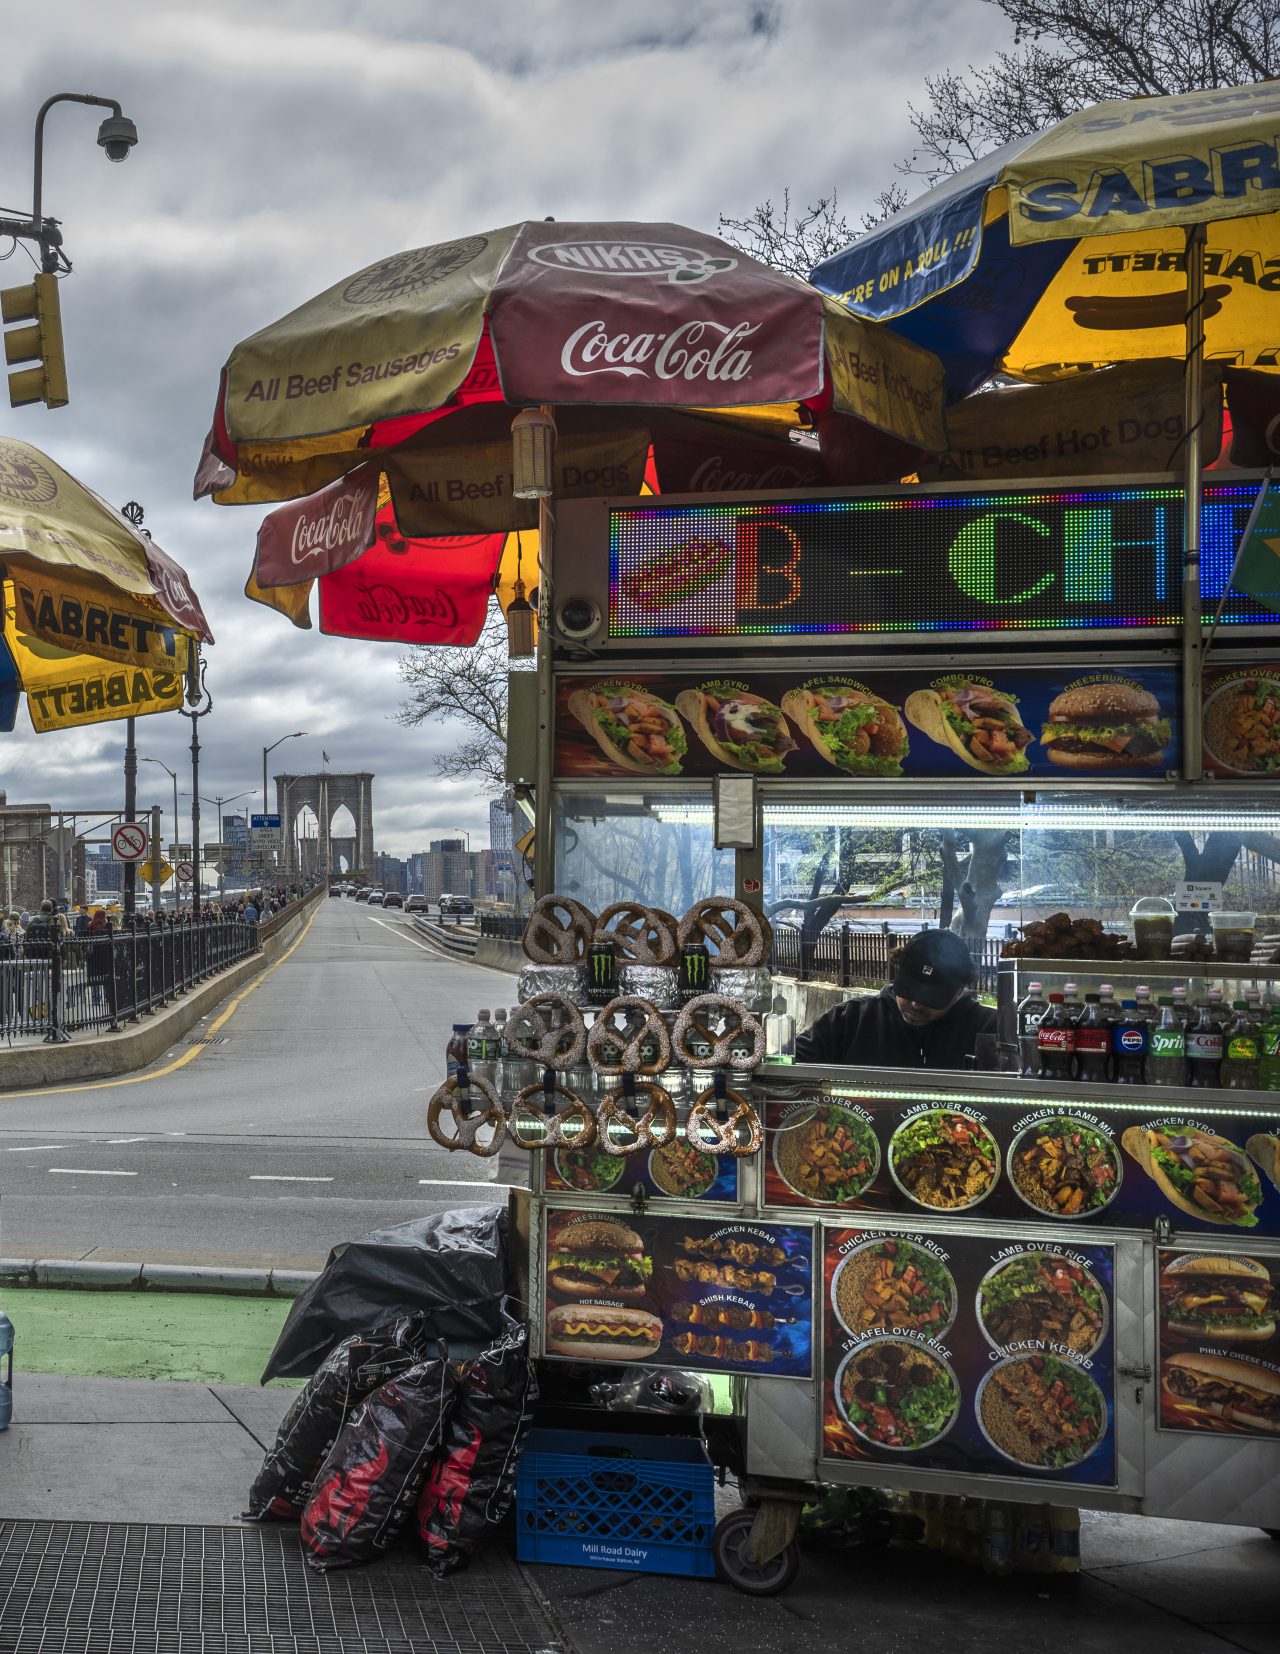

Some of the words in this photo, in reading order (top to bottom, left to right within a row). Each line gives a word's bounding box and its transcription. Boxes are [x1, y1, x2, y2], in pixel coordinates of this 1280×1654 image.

[1018, 137, 1280, 222] SABR
[554, 243, 686, 271] NIKAS
[879, 266, 900, 293] ON
[904, 260, 914, 281] A
[917, 238, 949, 271] ROLL
[561, 320, 763, 381] Coca-Cola
[244, 379, 280, 403] All
[285, 366, 344, 399] Beef
[348, 342, 461, 390] Sausages
[849, 352, 880, 385] Beef
[939, 451, 974, 476] All
[981, 437, 1054, 468] Beef
[1057, 425, 1112, 456] Hot
[410, 483, 439, 503] All
[446, 476, 504, 500] Beef
[562, 462, 629, 490] Dogs
[291, 486, 368, 565] Coca-Cola
[17, 581, 178, 657] SABRETT
[624, 680, 649, 696] GYRO
[695, 679, 720, 694] LAMB
[723, 679, 750, 692] GYRO
[827, 674, 876, 699] SANDWICH
[930, 673, 965, 689] COMBO
[967, 673, 994, 688] GYRO
[1063, 673, 1144, 694] CHEESEBURGER
[1204, 669, 1248, 696] CHICKEN
[1151, 1035, 1186, 1052] Sprit
[779, 1095, 821, 1120] CHICKEN
[823, 1095, 850, 1111] OVER
[850, 1100, 875, 1124] RICE
[900, 1101, 931, 1121] LAMB
[931, 1099, 963, 1113] OVER
[962, 1103, 988, 1123] RICE
[1012, 1108, 1056, 1133] CHICKEN
[1057, 1107, 1064, 1116] &
[1066, 1108, 1096, 1123] LAMB
[1096, 1118, 1116, 1139] MIX
[1140, 1116, 1186, 1133] CHICKEN
[1187, 1117, 1217, 1137] GYRO
[709, 1225, 746, 1242] CHICKEN
[747, 1226, 777, 1244] KEBAB
[838, 1230, 887, 1256] CHICKEN
[923, 1238, 951, 1263] RICE
[990, 1243, 1025, 1263] LAMB
[1026, 1242, 1063, 1255] OVER
[1064, 1248, 1094, 1270] RICE
[579, 1298, 593, 1306] HOT
[593, 1299, 625, 1309] SAUSAGE
[699, 1294, 725, 1307] SHISH
[726, 1294, 757, 1311] KEBAB
[841, 1326, 891, 1351] FALAFEL
[892, 1326, 926, 1342] OVER
[926, 1336, 953, 1360] RICE
[988, 1339, 1046, 1363] CHICKEN
[1048, 1341, 1095, 1371] KEBAB
[1199, 1347, 1228, 1357] PHILLY
[1229, 1351, 1261, 1365] CHEESE
[582, 1543, 599, 1554] Mill
[600, 1545, 623, 1556] Road
[624, 1547, 648, 1560] Dairy
